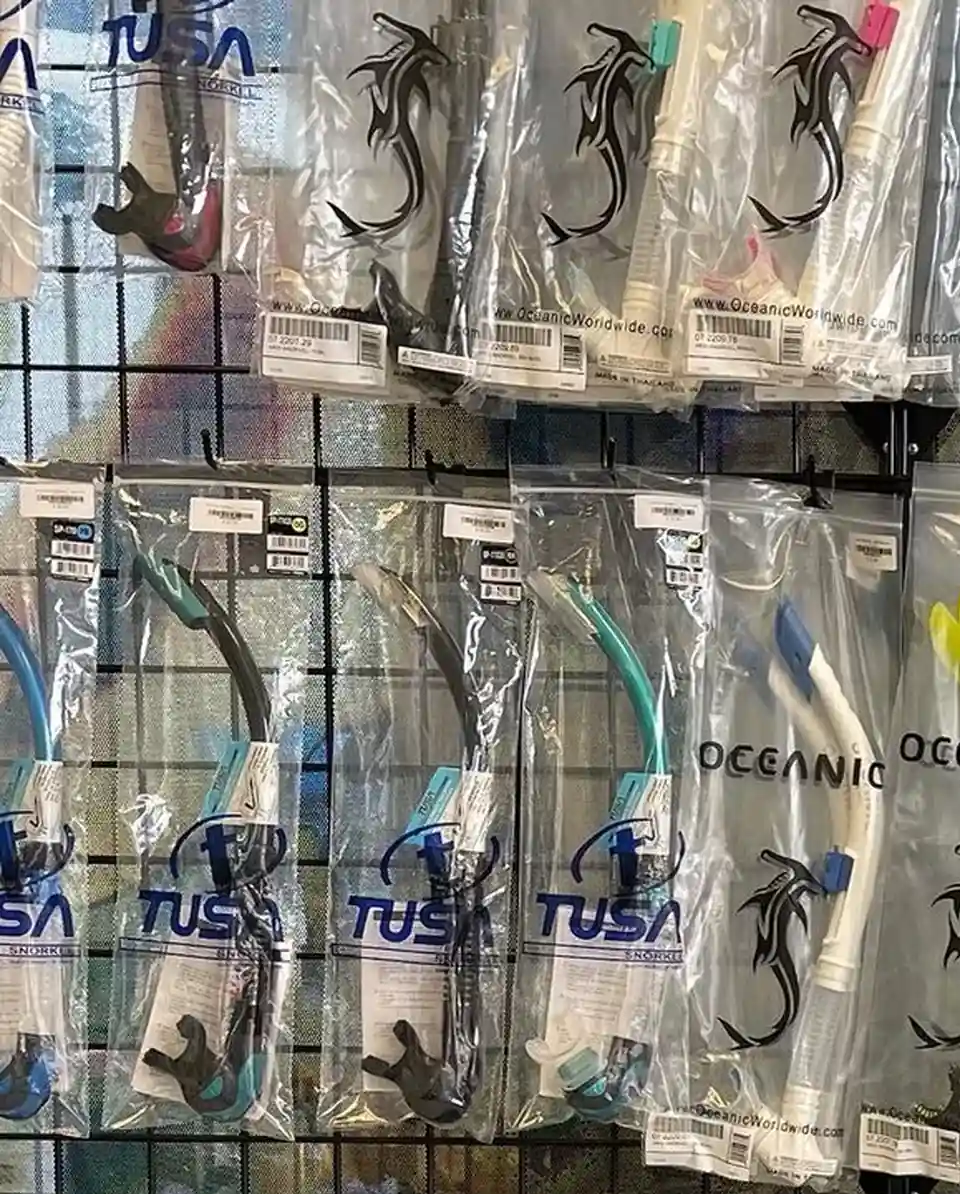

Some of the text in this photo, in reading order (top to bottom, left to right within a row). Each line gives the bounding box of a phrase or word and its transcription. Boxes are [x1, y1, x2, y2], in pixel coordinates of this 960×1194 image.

[102, 13, 255, 76] TUSA
[699, 741, 886, 789] OCEANIC
[0, 893, 74, 937] SA
[138, 888, 284, 942] TUSA
[536, 893, 682, 944] TUSA
